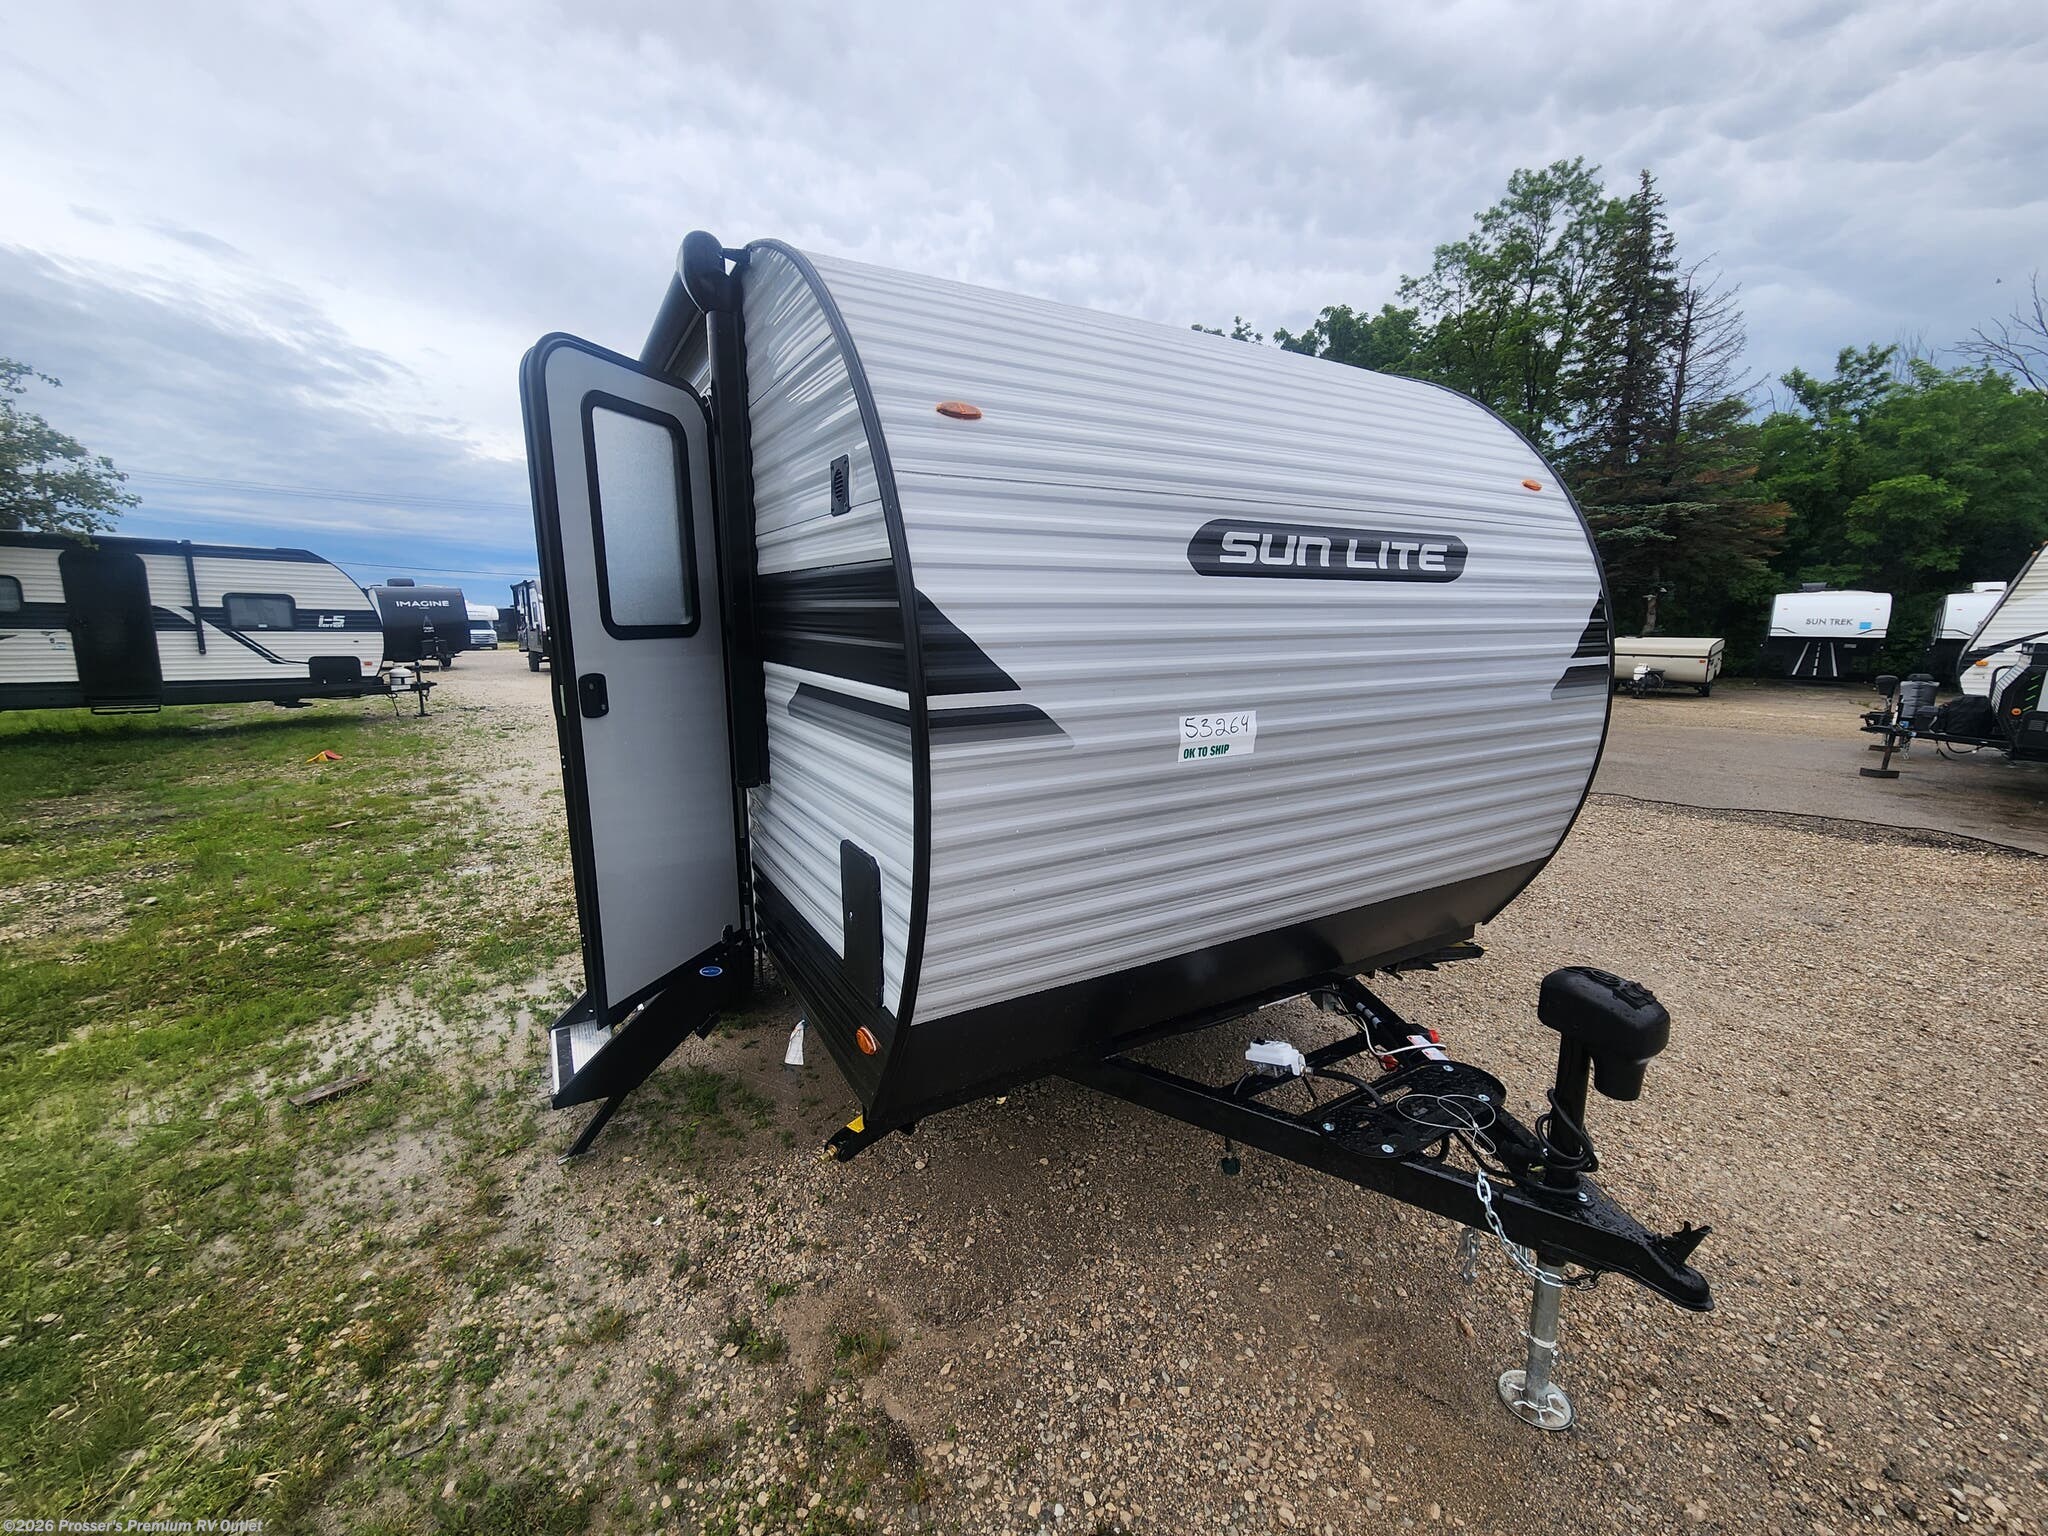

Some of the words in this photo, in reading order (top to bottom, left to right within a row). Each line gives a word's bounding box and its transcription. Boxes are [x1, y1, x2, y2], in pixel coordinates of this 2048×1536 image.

[1219, 531, 1332, 567] SUN
[1346, 539, 1448, 571] LITE
[1185, 714, 1249, 738] 53264
[1183, 748, 1196, 759] OK
[1198, 746, 1208, 757] TO
[1210, 744, 1230, 756] SHIP
